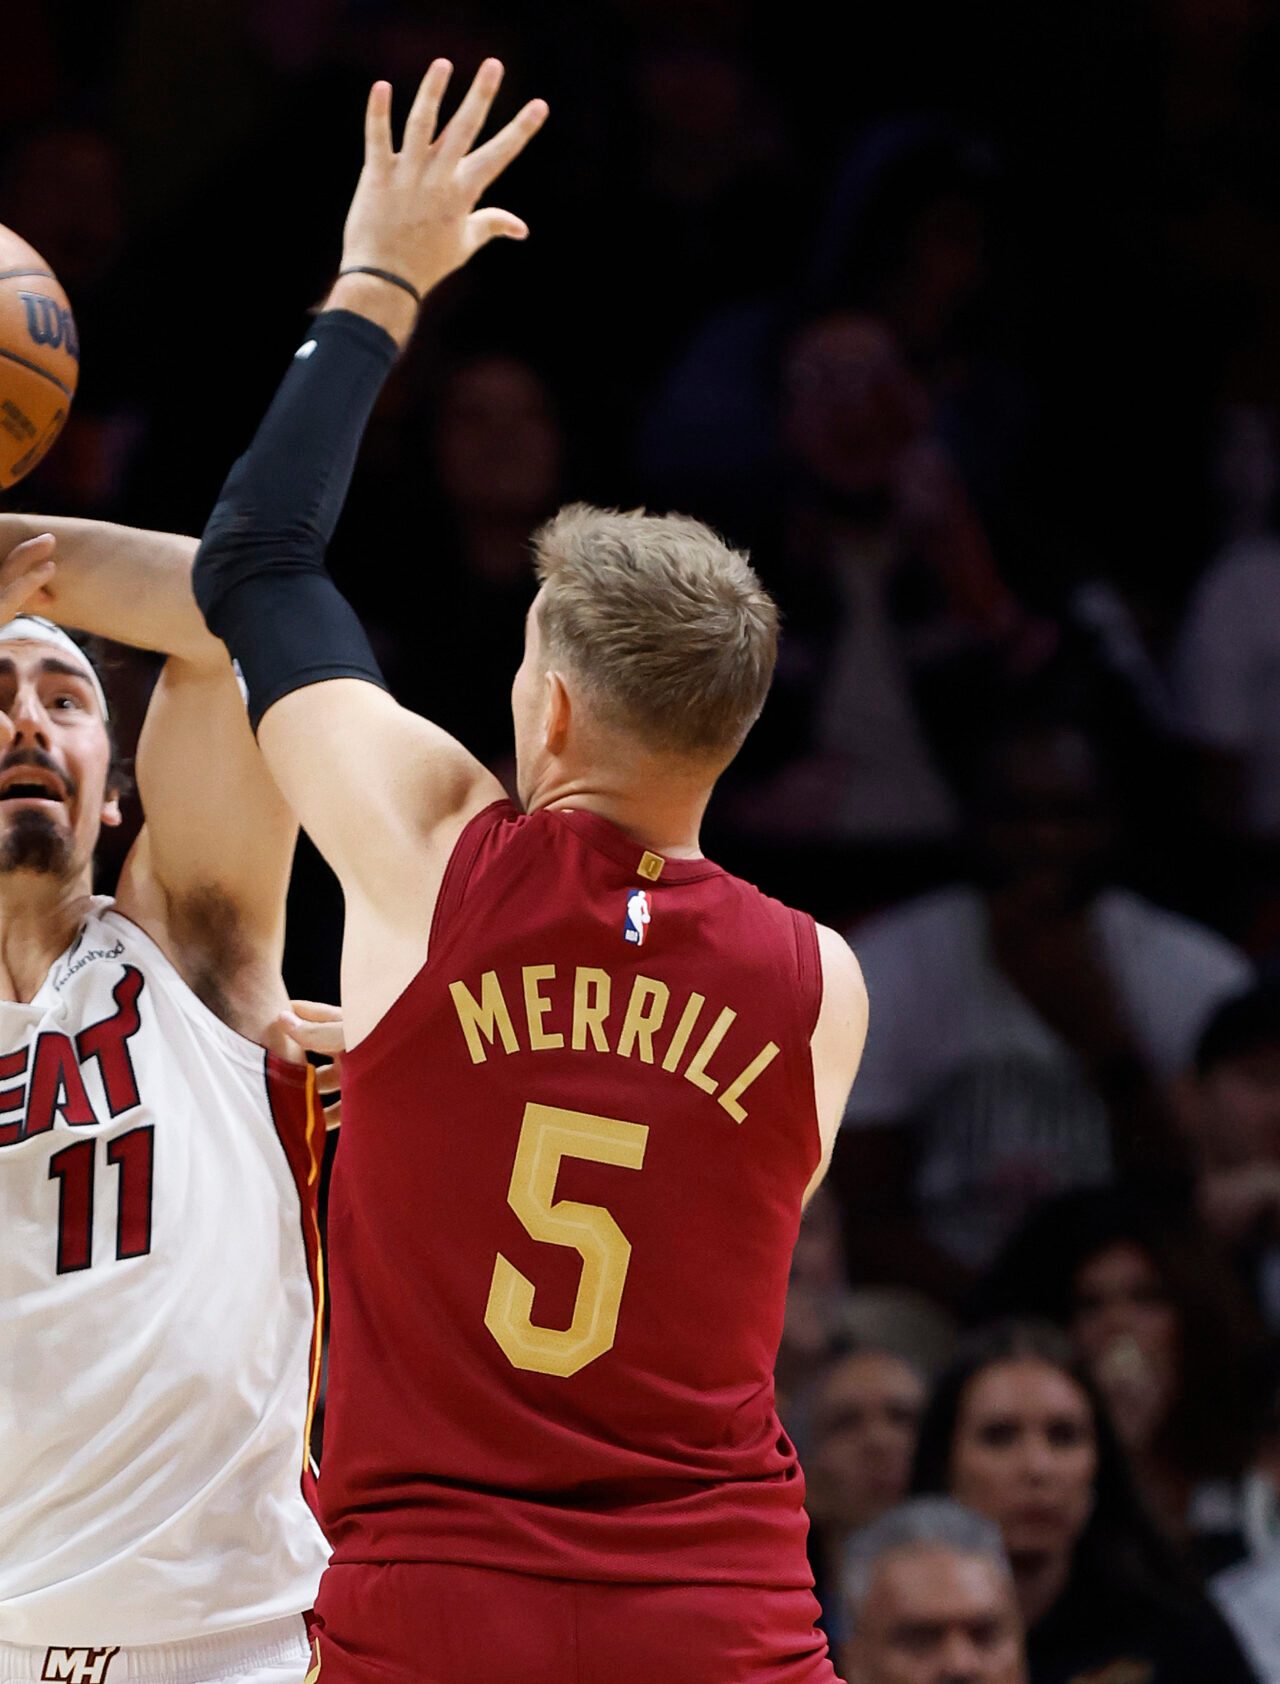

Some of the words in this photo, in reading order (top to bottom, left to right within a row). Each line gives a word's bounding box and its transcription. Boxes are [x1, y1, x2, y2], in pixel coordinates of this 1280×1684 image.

[448, 964, 780, 1124] MERRILL
[49, 1124, 155, 1275] 11
[484, 1102, 649, 1378] 5
